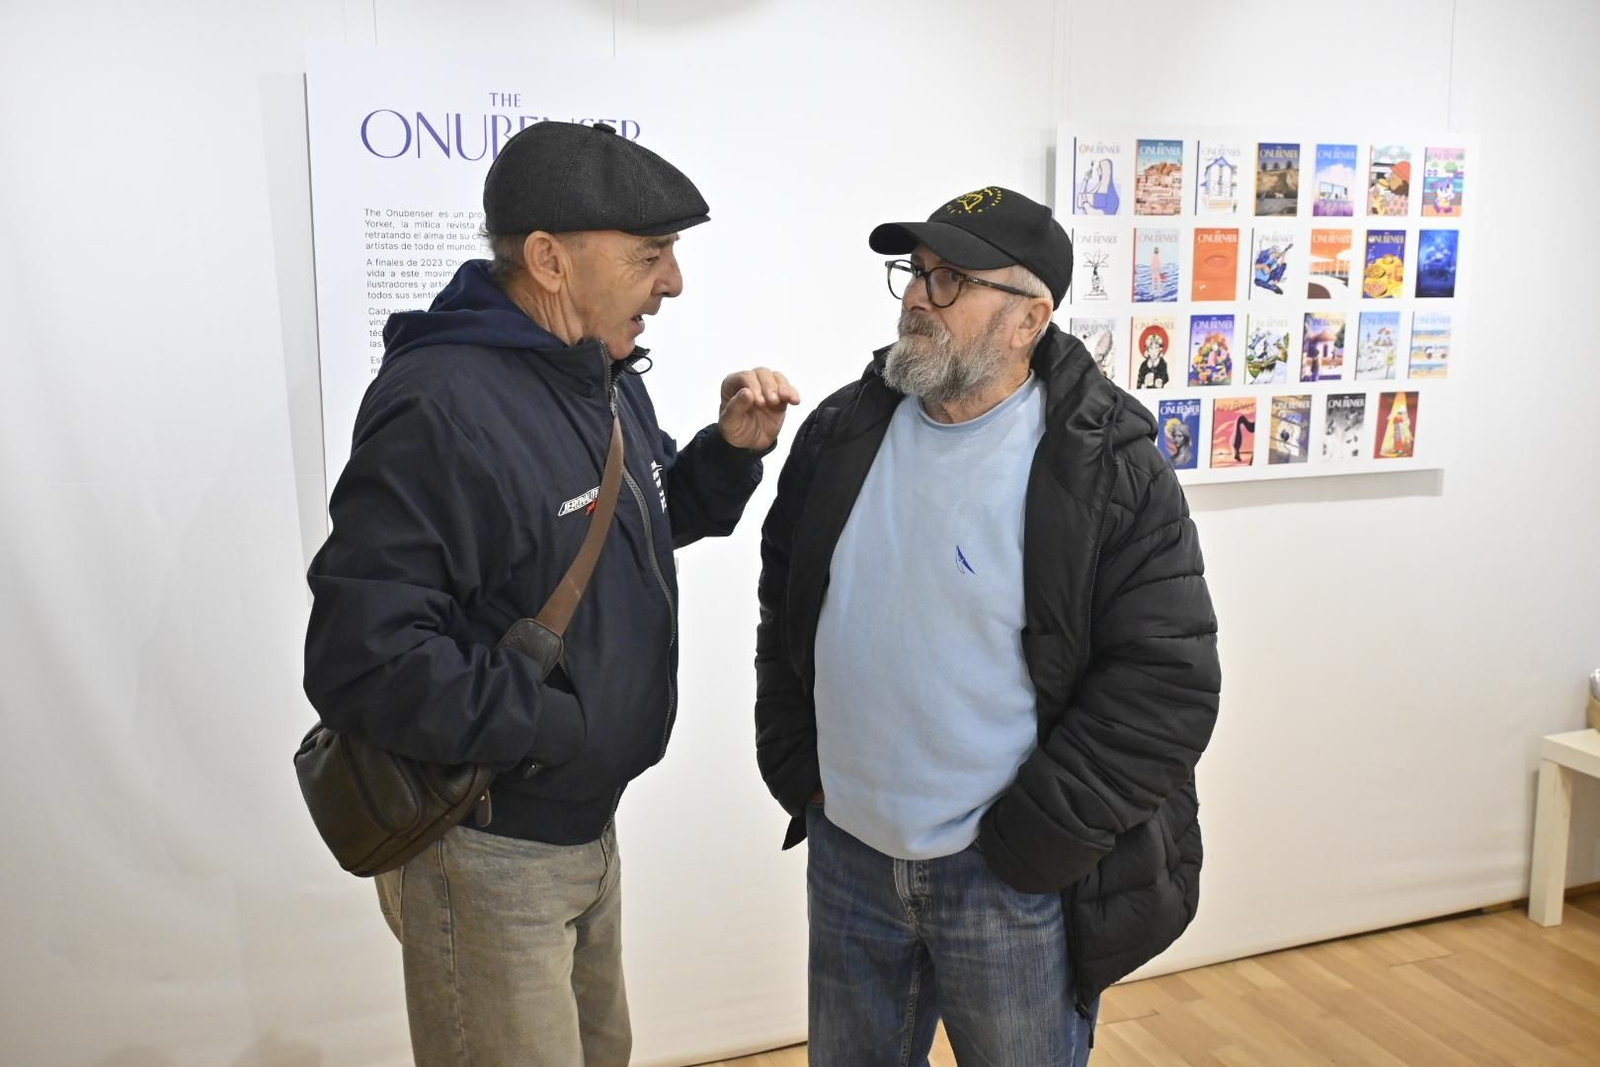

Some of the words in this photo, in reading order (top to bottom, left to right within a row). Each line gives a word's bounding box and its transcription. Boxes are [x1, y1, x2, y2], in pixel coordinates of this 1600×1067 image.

[490, 93, 521, 107] THE
[365, 209, 381, 217] The
[386, 209, 433, 218] Onubenser
[365, 221, 395, 229] Yorker,
